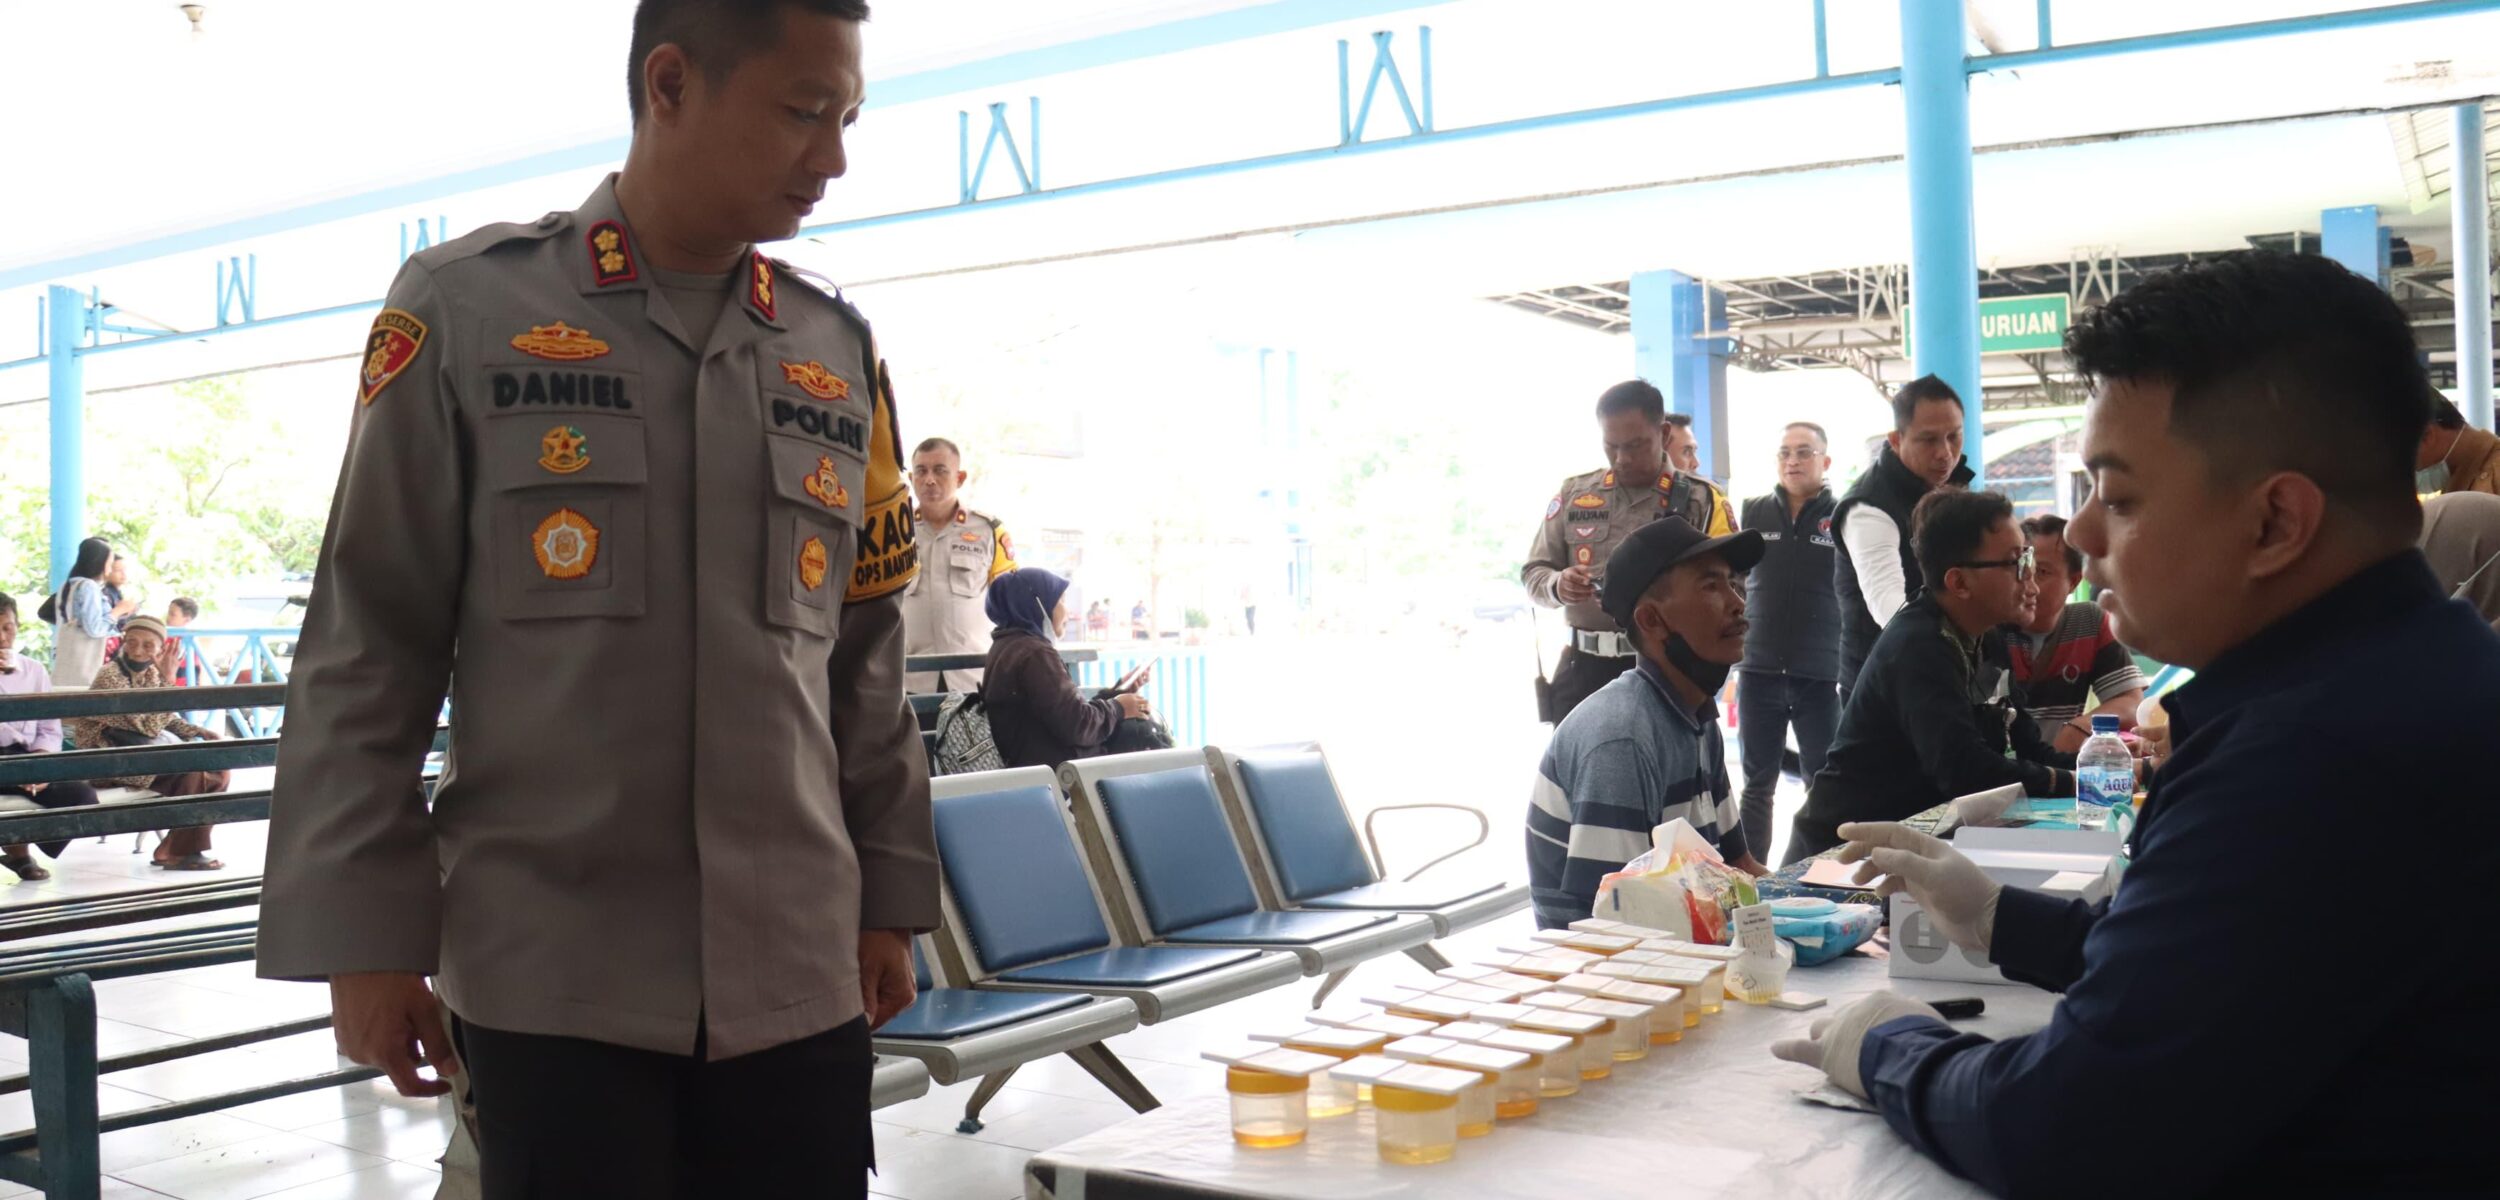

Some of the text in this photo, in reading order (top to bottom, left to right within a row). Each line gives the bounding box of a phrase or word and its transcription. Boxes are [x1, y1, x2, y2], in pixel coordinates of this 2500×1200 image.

[1981, 311, 2057, 338] URUAN
[493, 371, 633, 410] DANIEL
[772, 398, 864, 452] POLRI
[952, 544, 983, 554] POLRI
[855, 561, 880, 587] OPS
